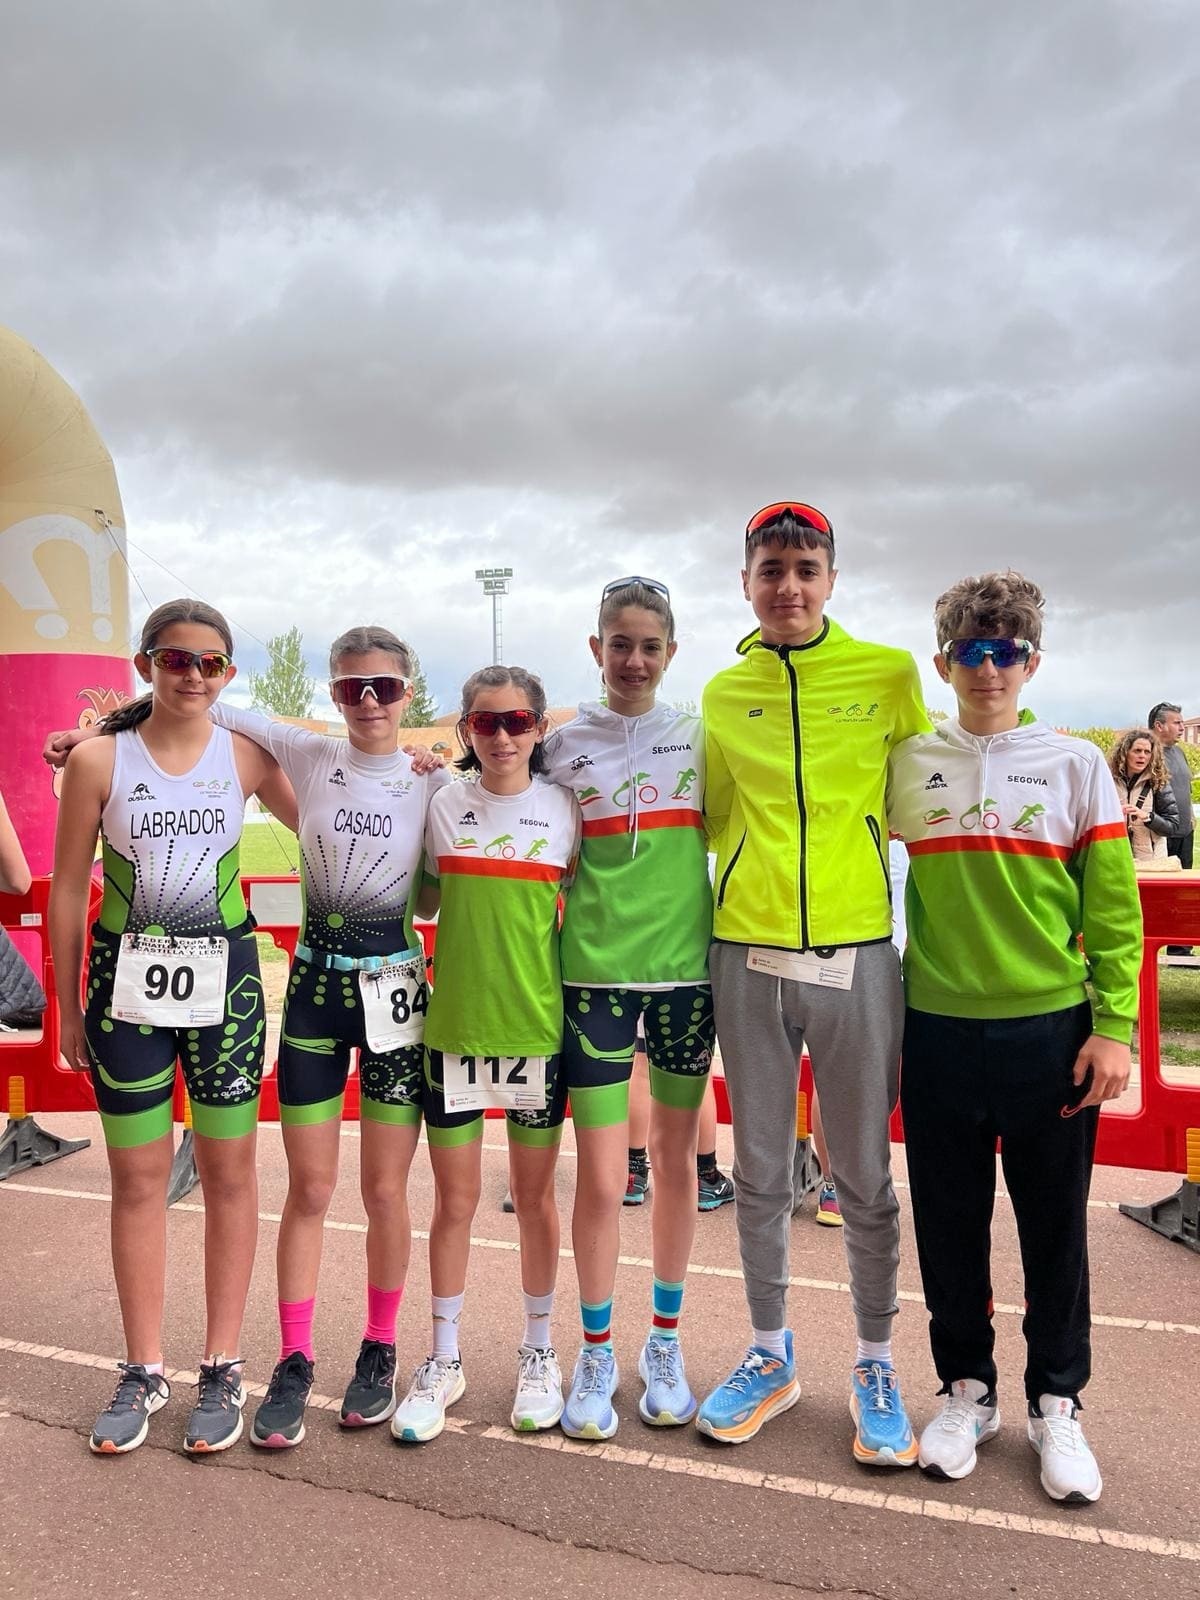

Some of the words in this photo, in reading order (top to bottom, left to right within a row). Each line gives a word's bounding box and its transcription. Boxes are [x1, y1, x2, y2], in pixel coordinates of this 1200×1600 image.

[652, 744, 691, 754] SEGOVIA
[1008, 775, 1047, 786] SEGOVIA
[130, 808, 226, 839] LABRADOR
[334, 808, 392, 838] CASADO
[519, 818, 549, 828] SEGOVIA
[144, 964, 194, 1001] 90
[391, 982, 429, 1024] 84
[461, 1056, 527, 1085] 112
